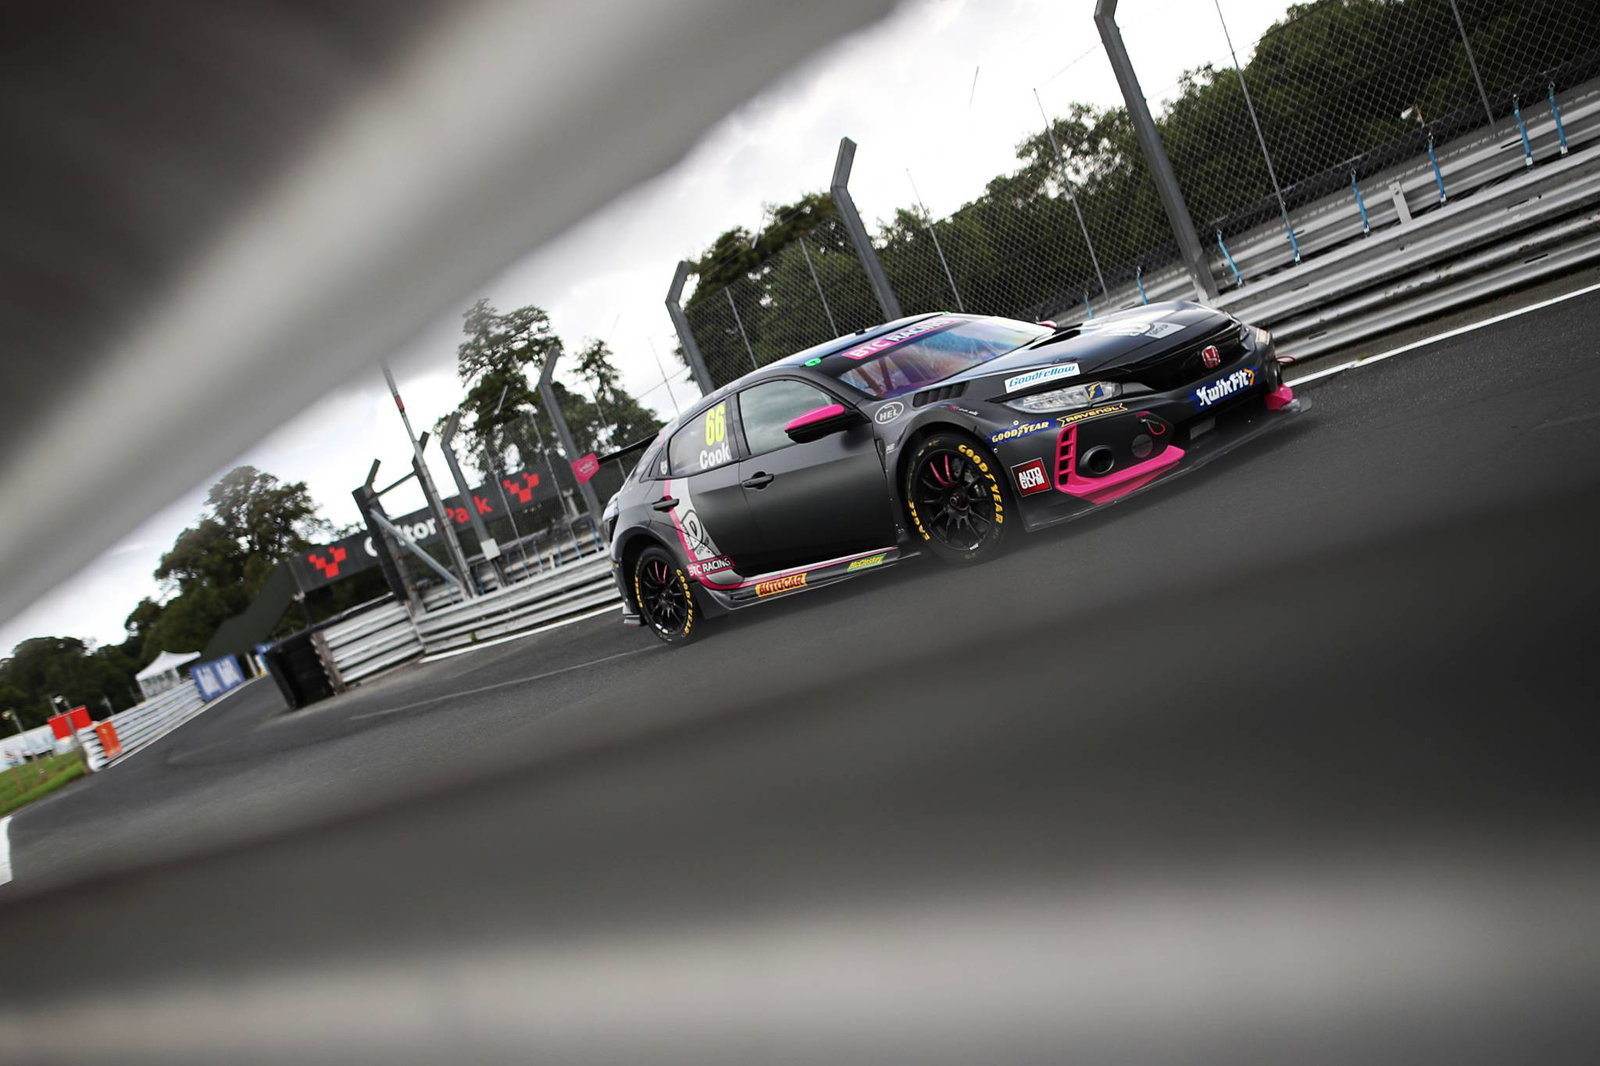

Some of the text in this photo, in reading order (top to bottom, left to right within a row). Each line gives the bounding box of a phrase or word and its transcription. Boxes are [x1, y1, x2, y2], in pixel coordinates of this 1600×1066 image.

[849, 338, 891, 357] BTC
[879, 408, 898, 422] HEL
[1065, 405, 1120, 423] RAVENOL
[705, 404, 725, 446] 66
[991, 420, 1050, 444] GOODYEAR
[699, 442, 732, 470] Cook
[958, 444, 1004, 525] GOODYEAR
[1018, 466, 1042, 483] AUTO
[1020, 472, 1046, 490] GLYM
[444, 495, 494, 523] Pak
[688, 557, 732, 577] BTC RACING
[758, 574, 805, 597] AUTOCAR
